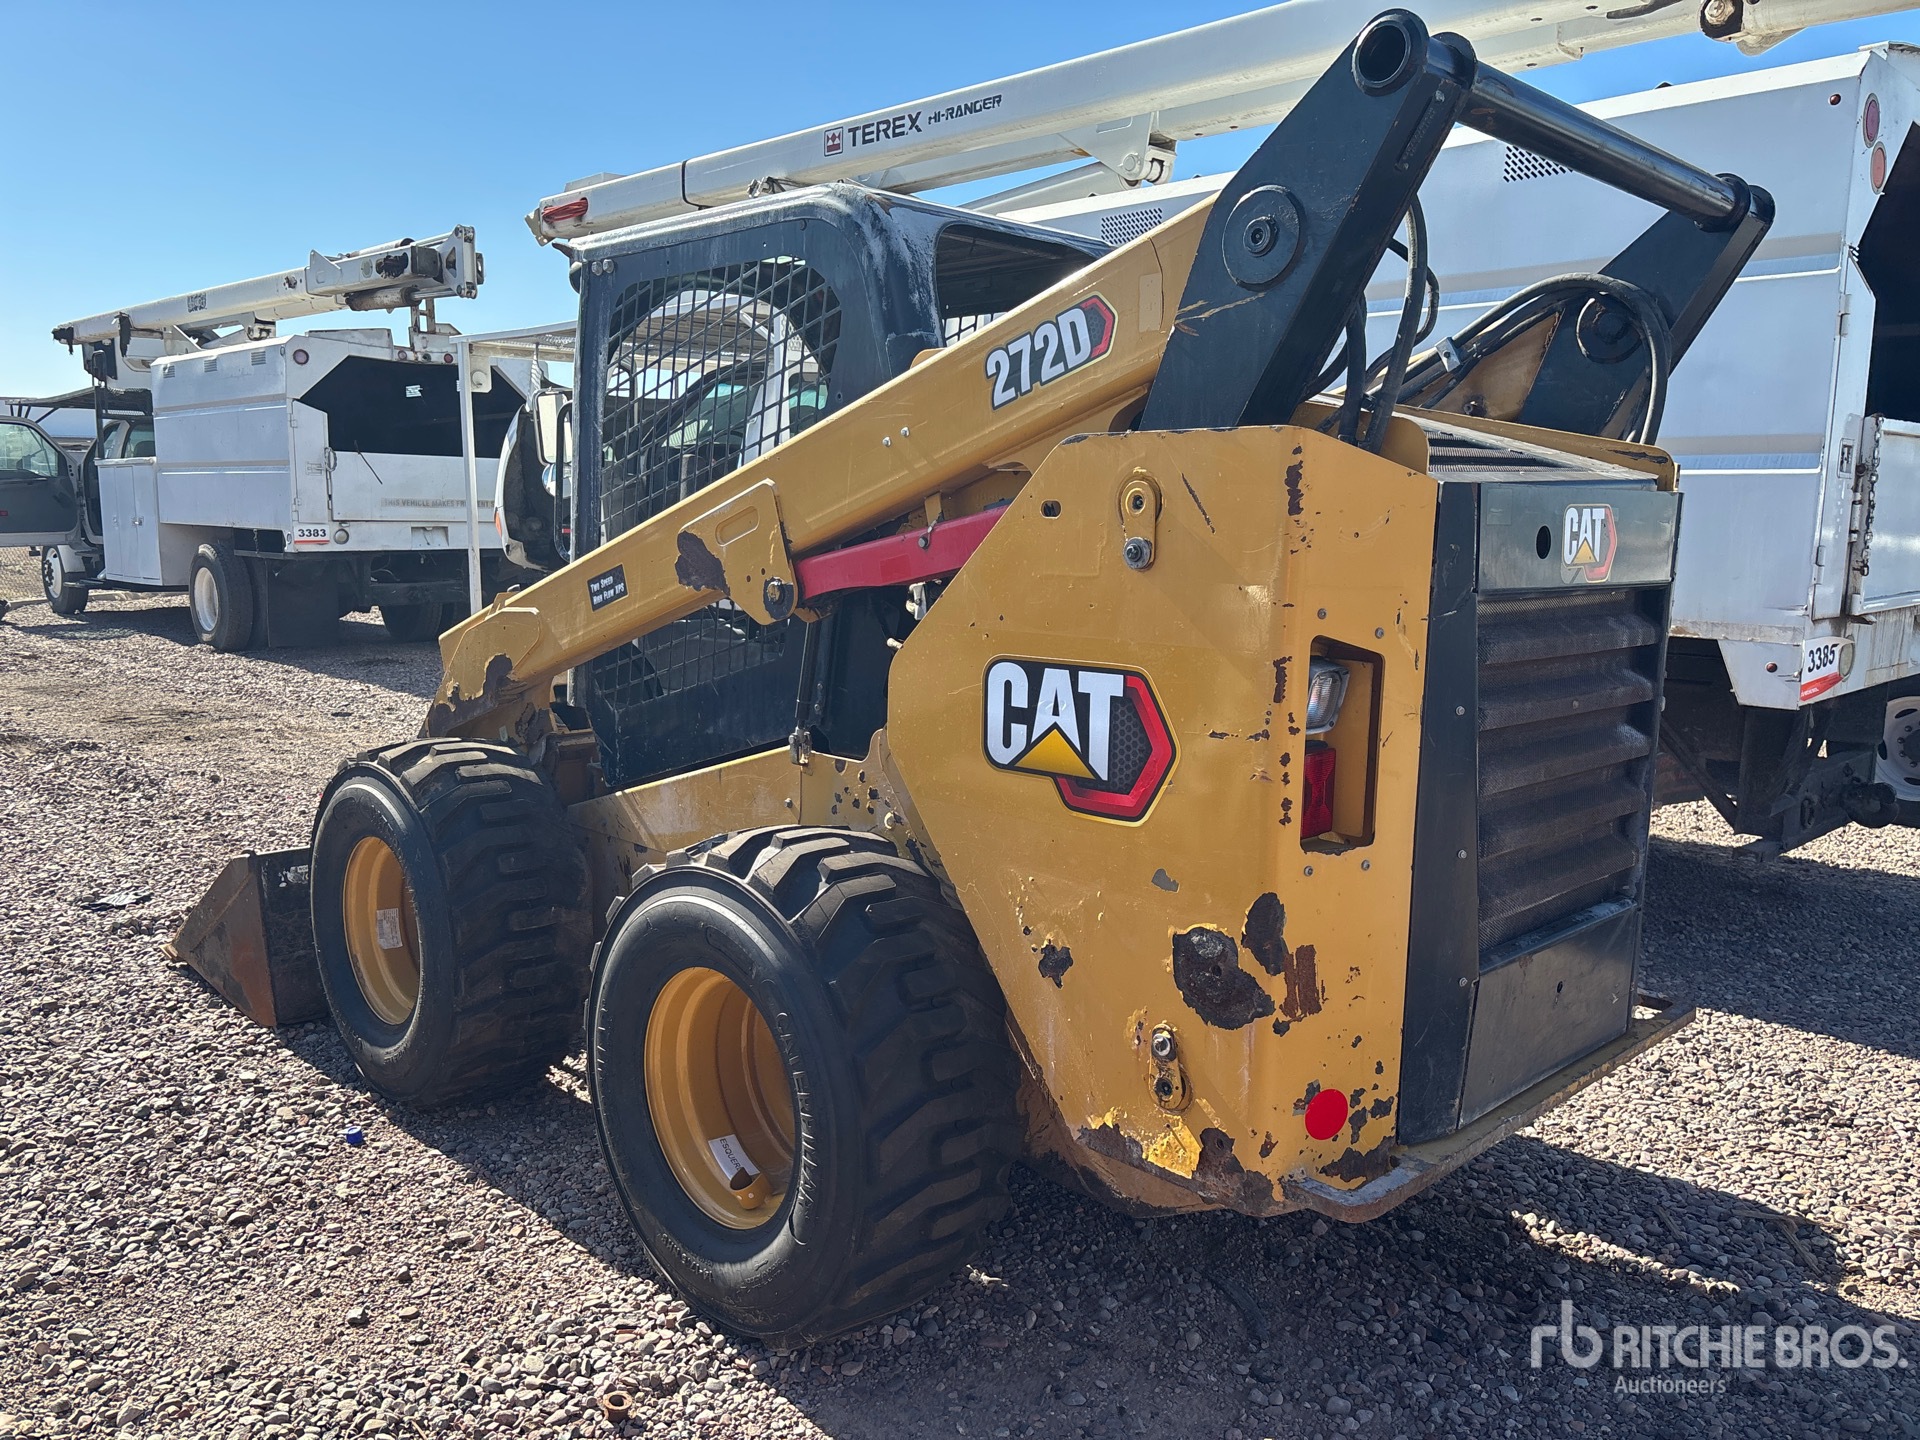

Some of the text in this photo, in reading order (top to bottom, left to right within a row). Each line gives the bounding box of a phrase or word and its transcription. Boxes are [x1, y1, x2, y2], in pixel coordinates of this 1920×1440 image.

[848, 94, 1002, 147] TEREX HI-RANGER
[986, 307, 1092, 408] 272D
[402, 499, 430, 508] VEHICLE
[432, 499, 454, 508] MAKES
[298, 529, 327, 538] 3383
[1564, 507, 1605, 565] CAT
[1808, 643, 1839, 673] 3385
[987, 661, 1124, 781] CAT
